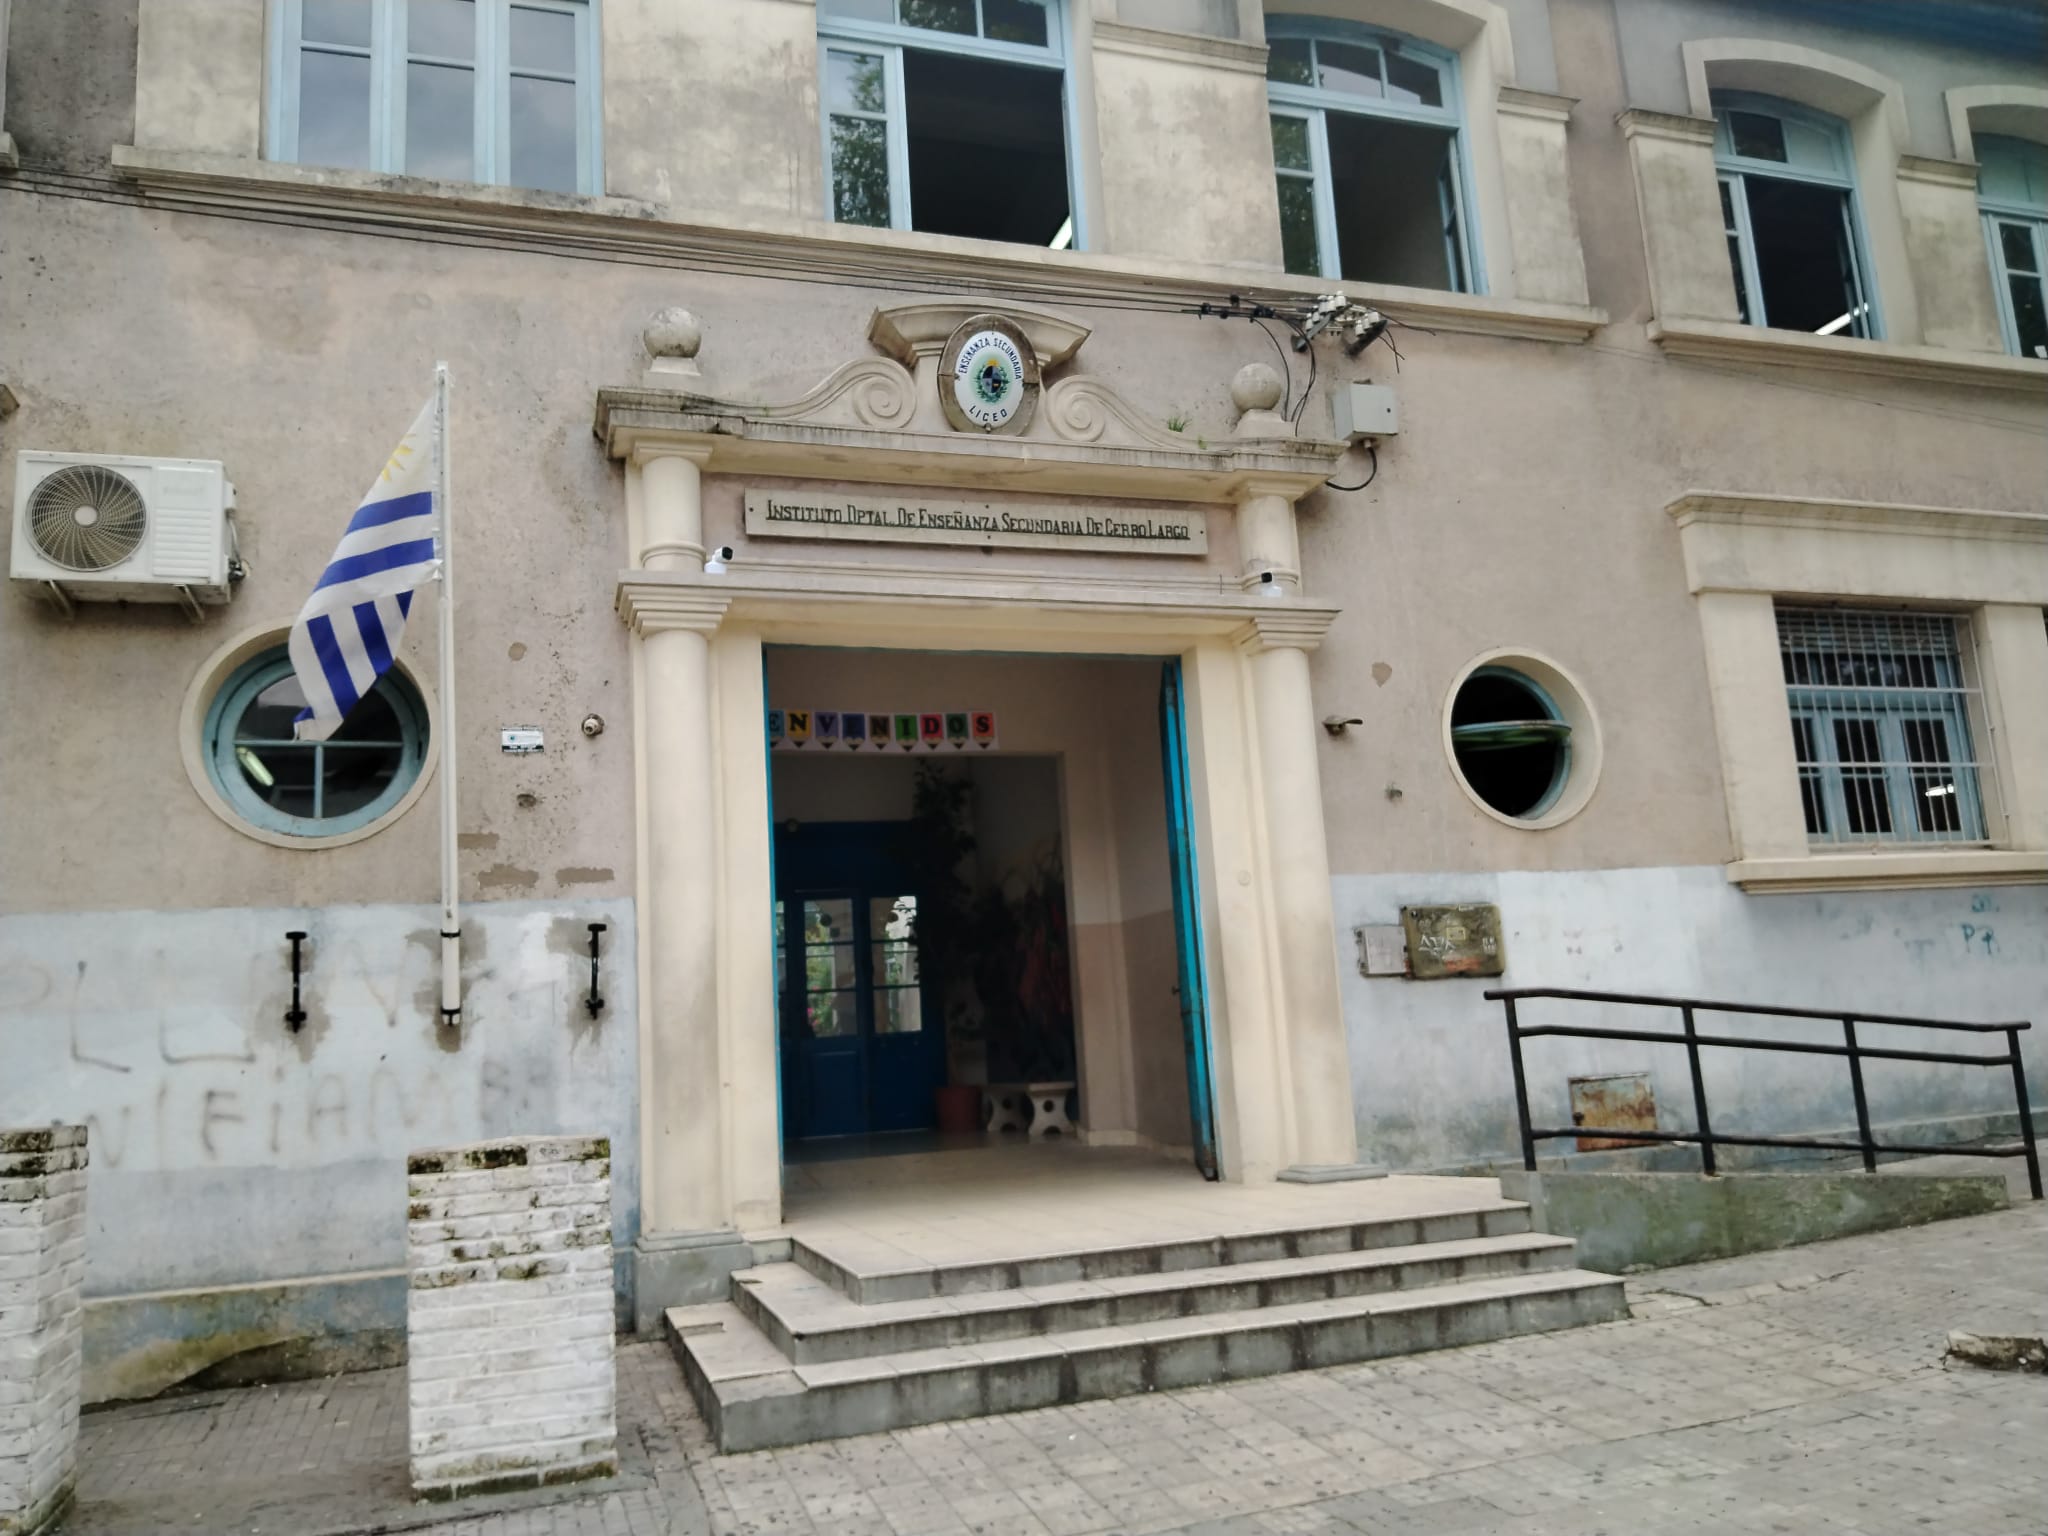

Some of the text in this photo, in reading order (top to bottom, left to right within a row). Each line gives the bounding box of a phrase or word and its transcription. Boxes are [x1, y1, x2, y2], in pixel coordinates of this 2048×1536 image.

[994, 337, 1022, 380] SECUNDARIA
[969, 405, 1008, 421] LICEO
[767, 500, 842, 523] INSTITUTO
[897, 507, 916, 527] DE
[919, 508, 999, 531] ENSEÑANZA
[1002, 513, 1083, 536] SECUNDARIA
[1086, 516, 1103, 536] DE
[1105, 518, 1146, 538] CERRO
[1148, 520, 1190, 540] LARGO
